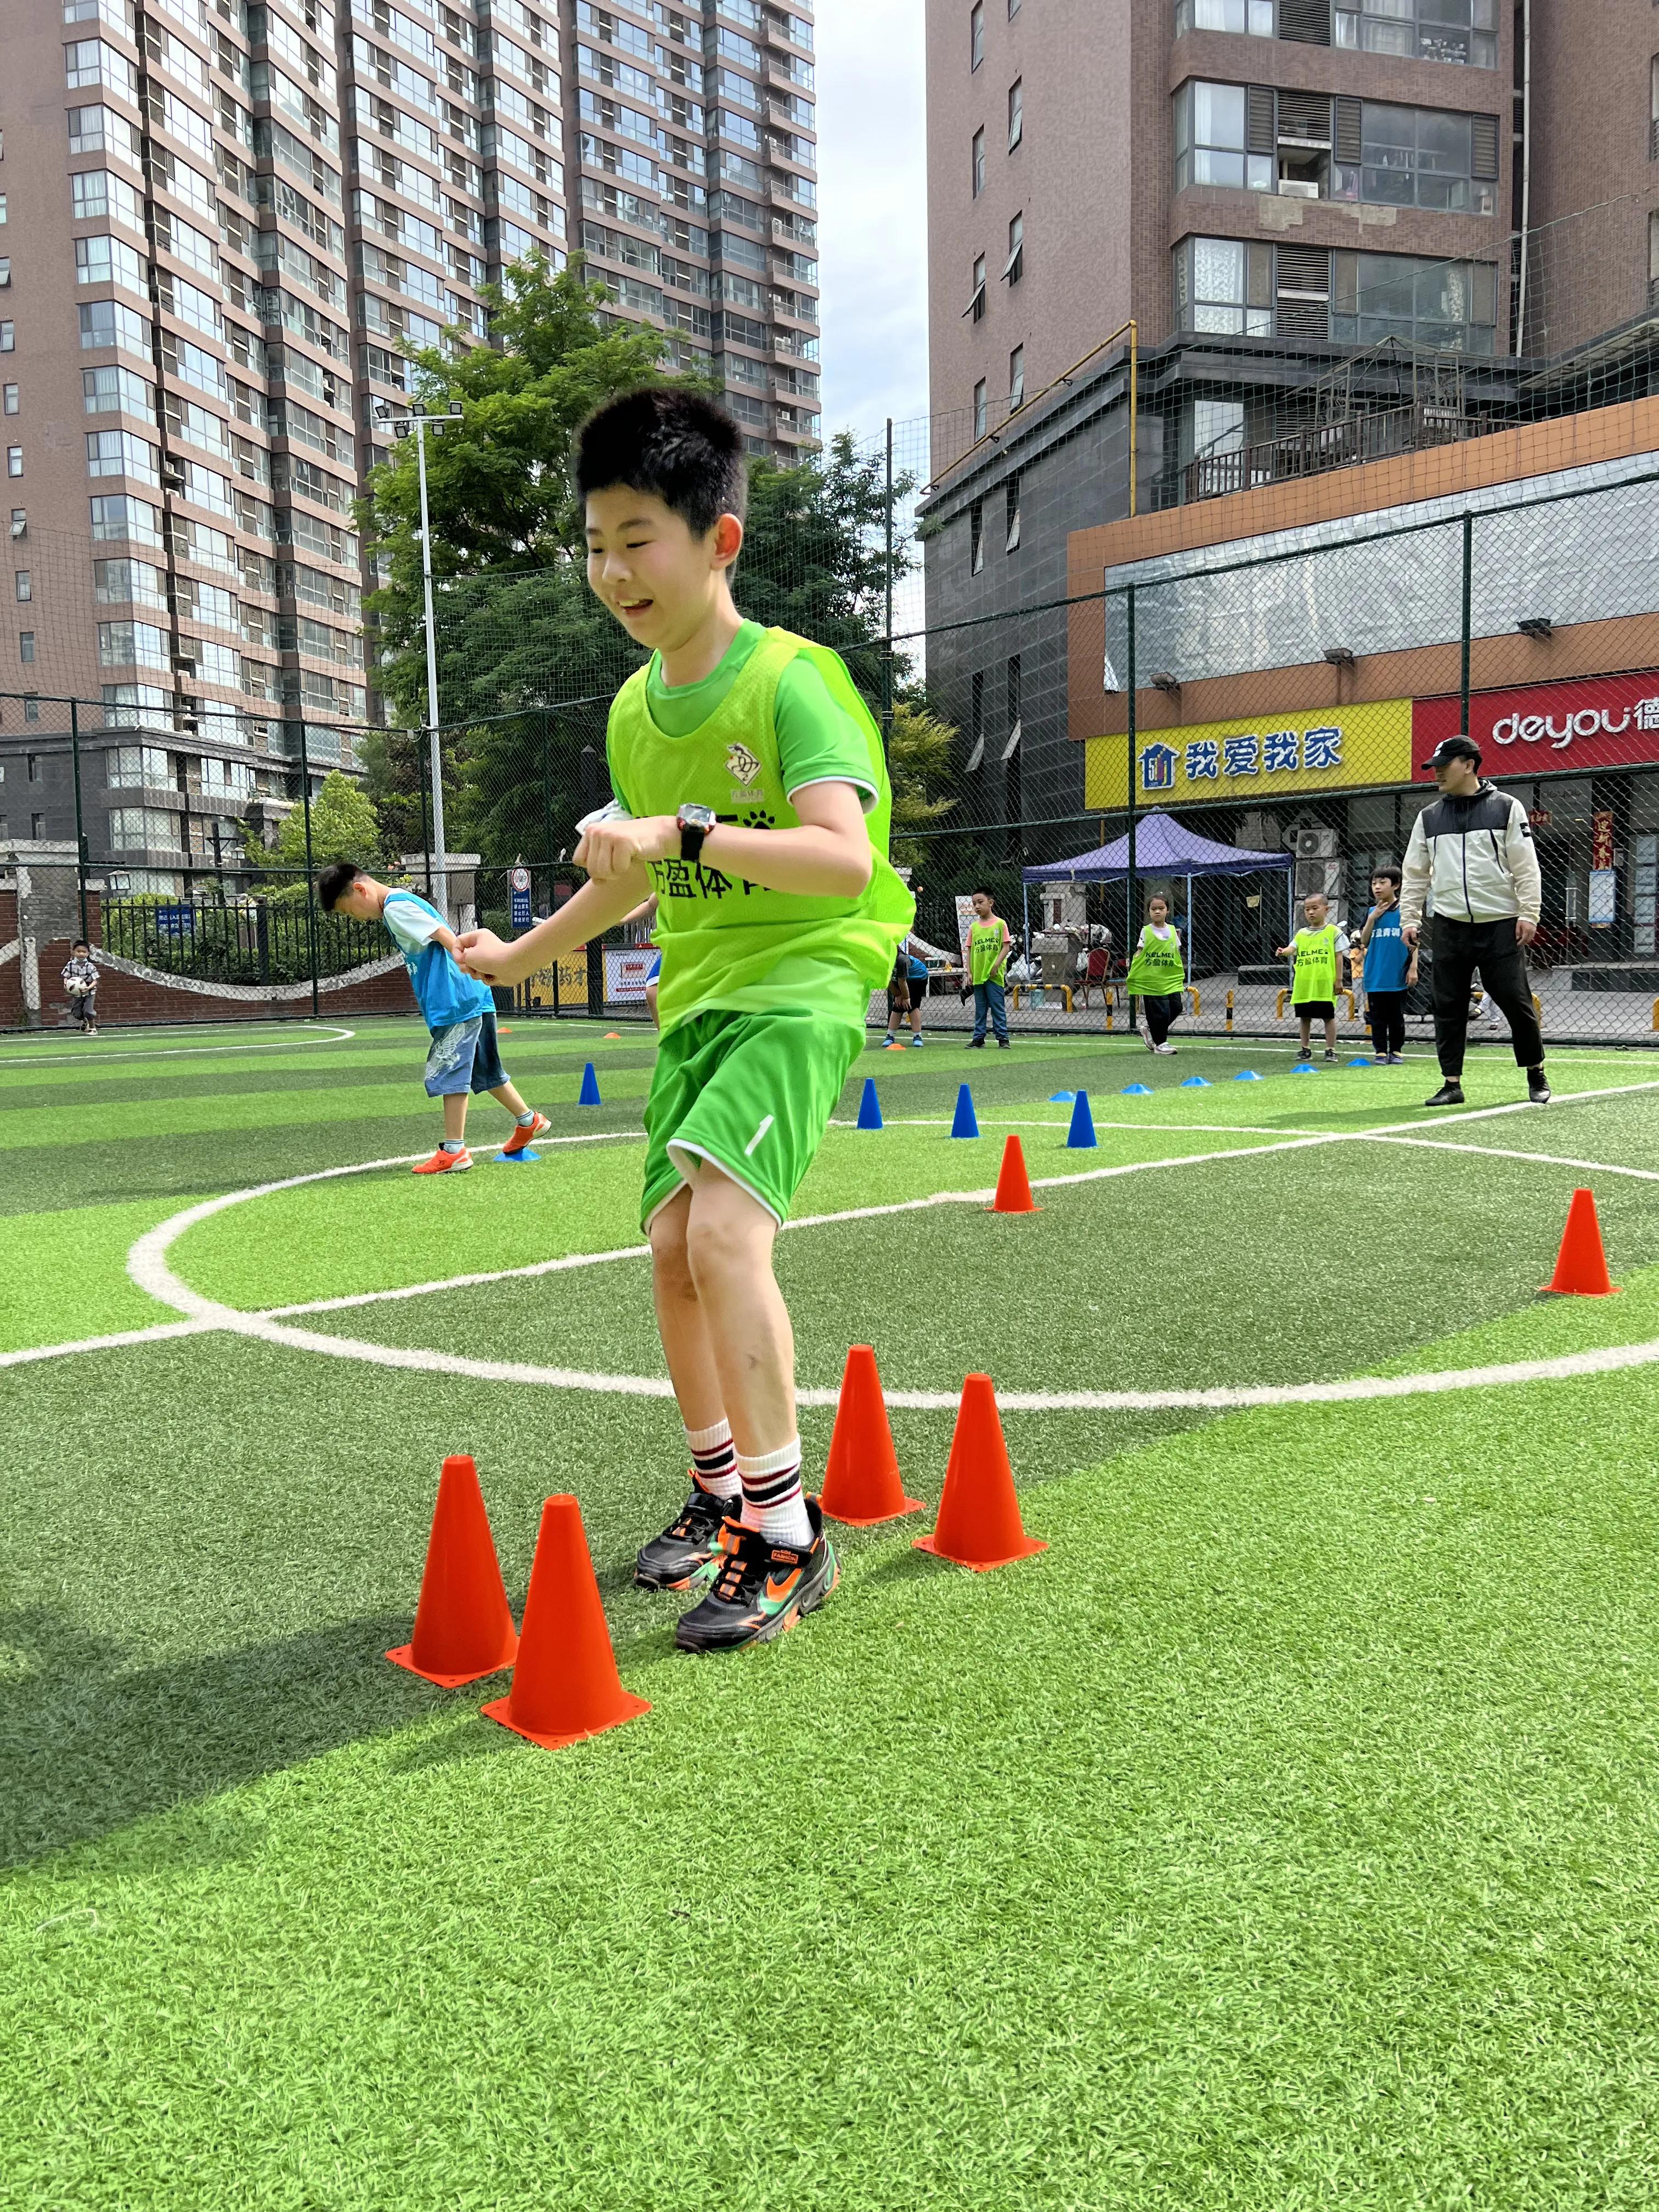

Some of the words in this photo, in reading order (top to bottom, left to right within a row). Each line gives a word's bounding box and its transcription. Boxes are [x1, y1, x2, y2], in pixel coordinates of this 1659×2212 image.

[1185, 726, 1342, 780] 我爱我家
[649, 857, 771, 899] 方盈体
